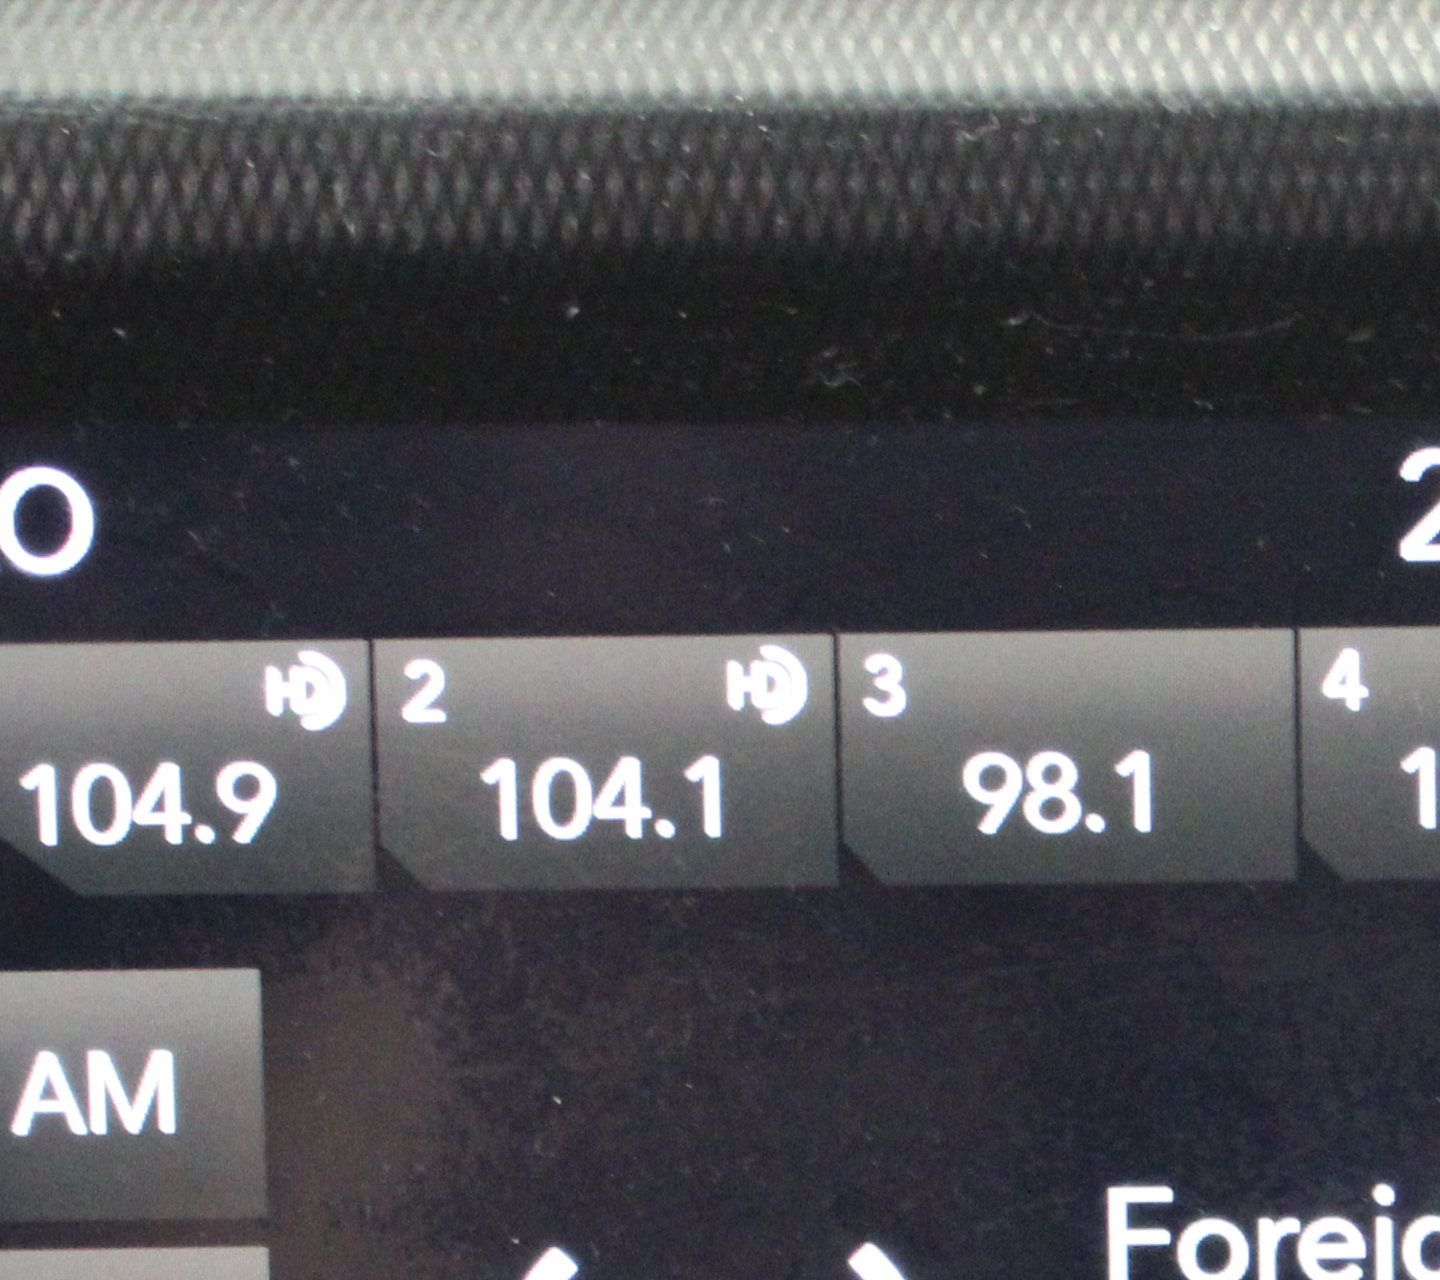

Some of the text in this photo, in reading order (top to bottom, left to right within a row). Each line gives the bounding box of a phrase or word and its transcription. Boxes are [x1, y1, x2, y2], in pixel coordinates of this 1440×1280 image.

[263, 648, 349, 732] HD
[400, 657, 448, 725] 2
[724, 642, 810, 726] HD
[862, 651, 908, 719] 3
[1320, 646, 1371, 713] 4
[19, 759, 279, 848] 104.9
[479, 753, 723, 842] 104.1
[961, 748, 1154, 836] 98.1
[10, 1047, 178, 1137] AM
